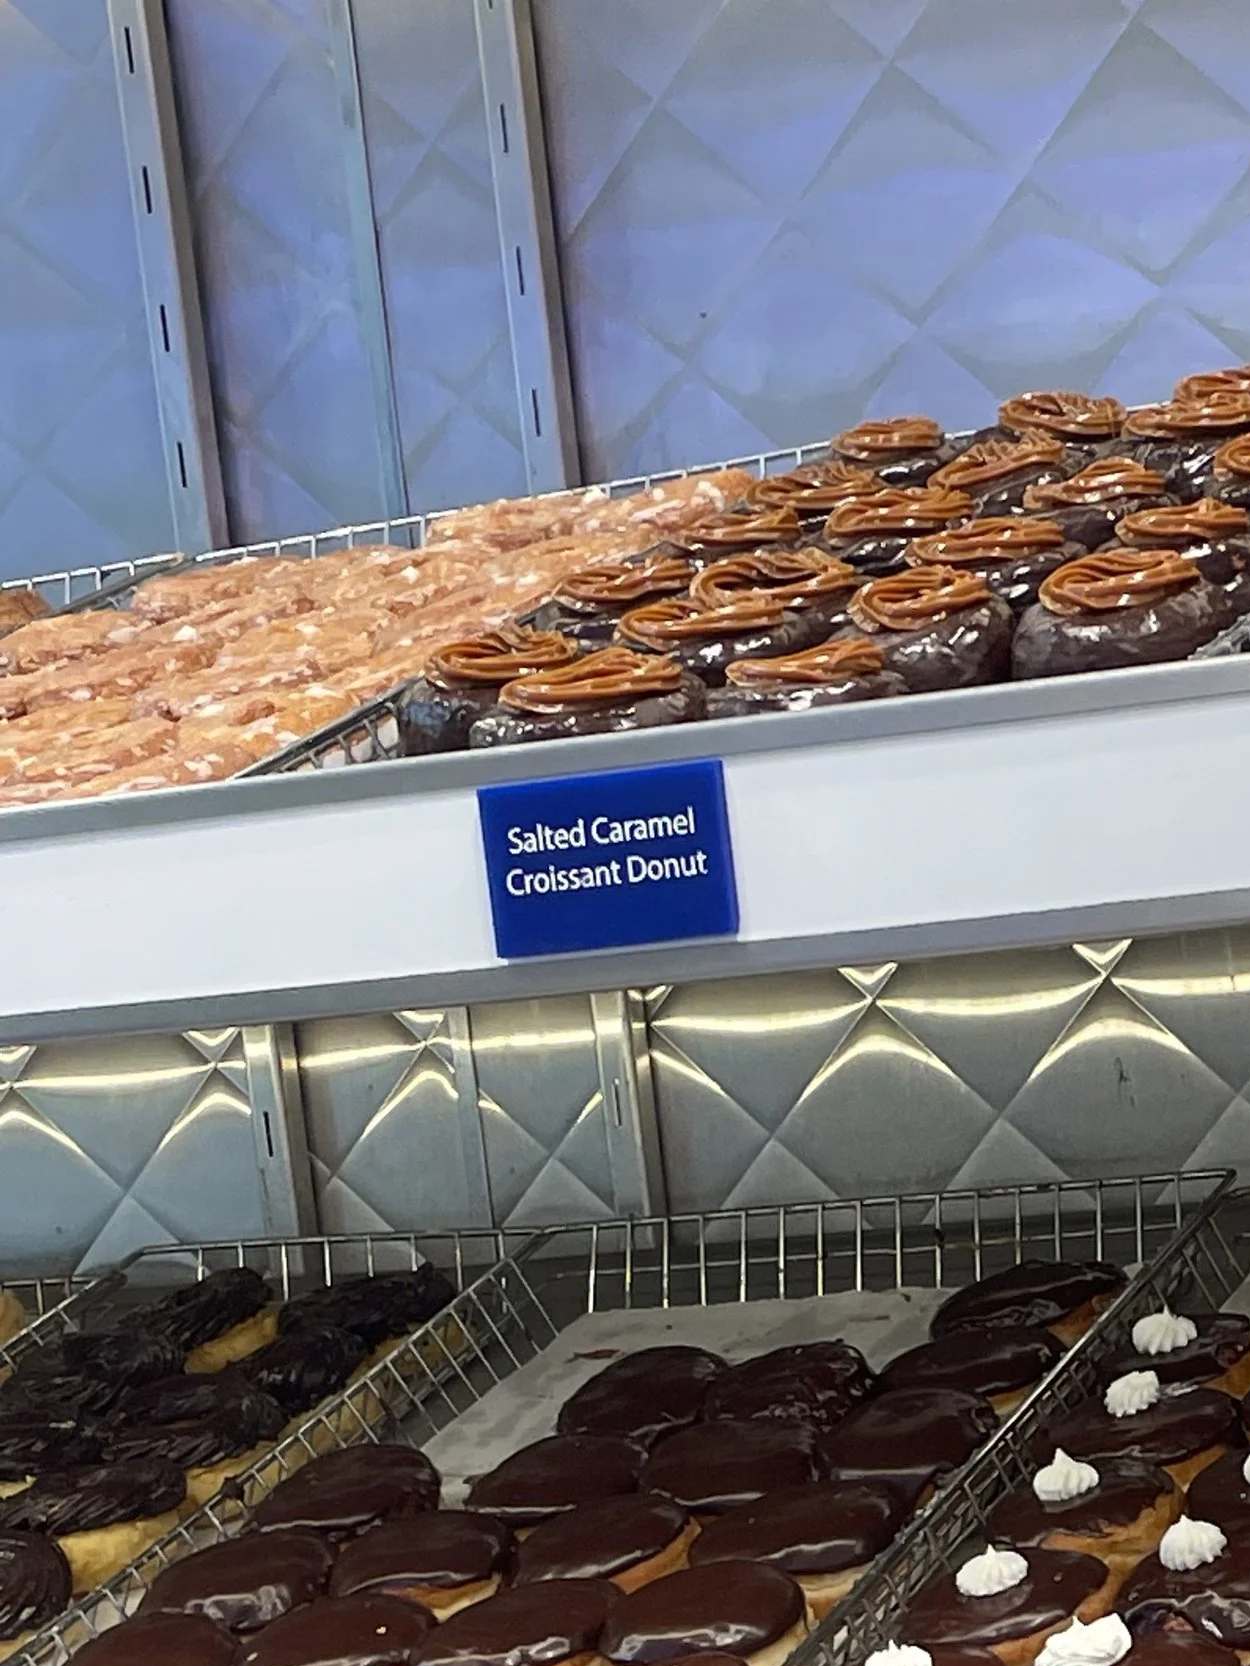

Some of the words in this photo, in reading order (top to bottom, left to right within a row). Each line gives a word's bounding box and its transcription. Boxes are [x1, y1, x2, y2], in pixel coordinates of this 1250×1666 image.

[507, 819, 587, 855] Salted
[590, 807, 697, 845] Caramel
[506, 861, 623, 896] Croissant
[626, 851, 709, 883] Donut
